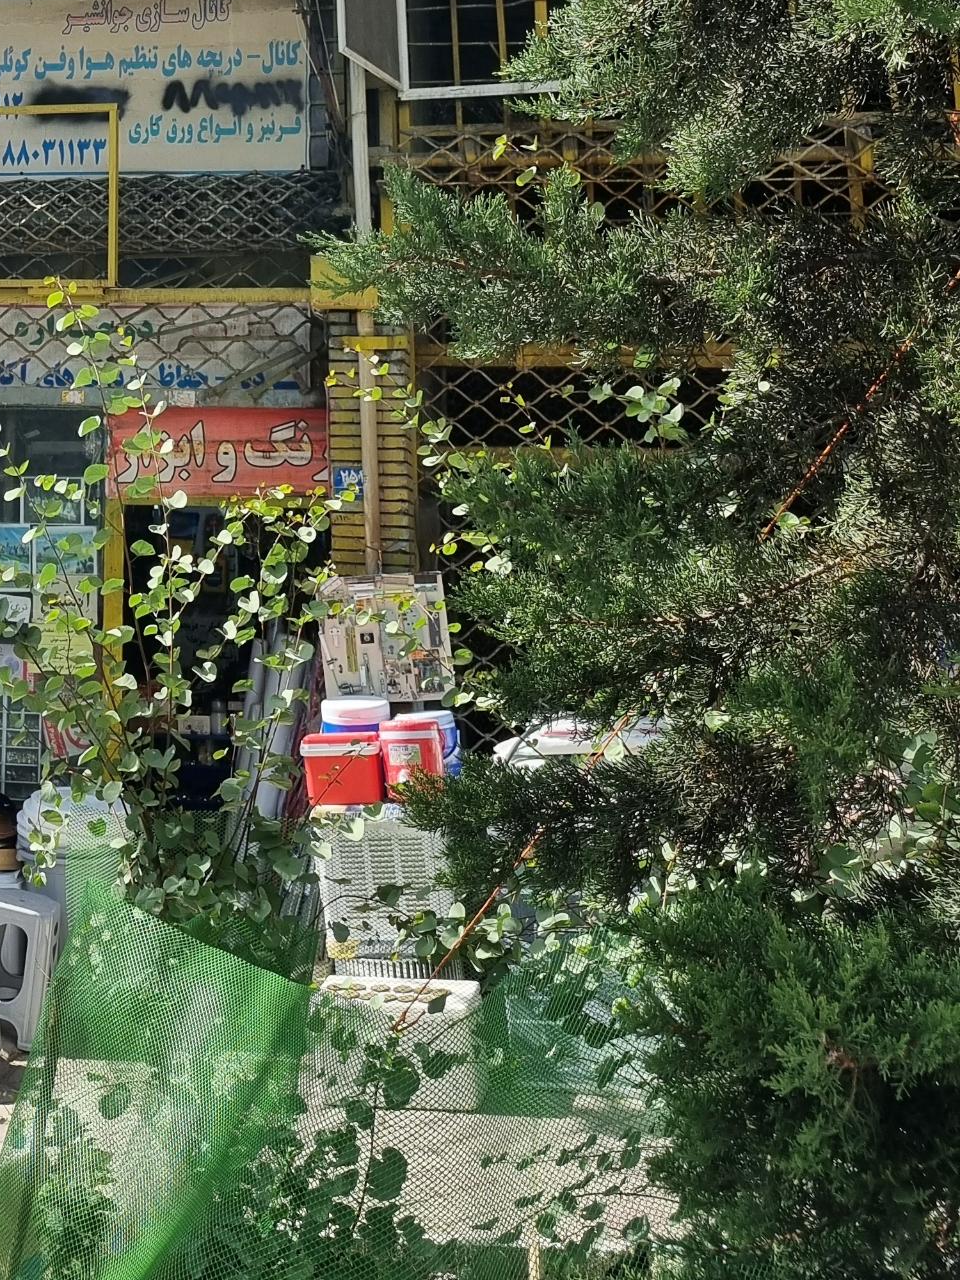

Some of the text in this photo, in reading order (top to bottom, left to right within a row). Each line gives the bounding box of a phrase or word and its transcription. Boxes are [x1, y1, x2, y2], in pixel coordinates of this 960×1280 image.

[62, 0, 133, 34] جوانشیر
[79, 46, 114, 78] هوا
[119, 44, 158, 77] تنظیم
[162, 44, 192, 77] های
[196, 46, 243, 78] دریچه
[262, 40, 303, 73] کانال
[128, 114, 163, 144] کاری
[166, 119, 193, 144] ورق
[197, 114, 241, 144] انواع
[246, 122, 253, 143] و
[2, 138, 107, 167] ۸۸۰۳۱۱۳۳
[158, 362, 209, 389] حفاظ
[211, 440, 237, 483] و
